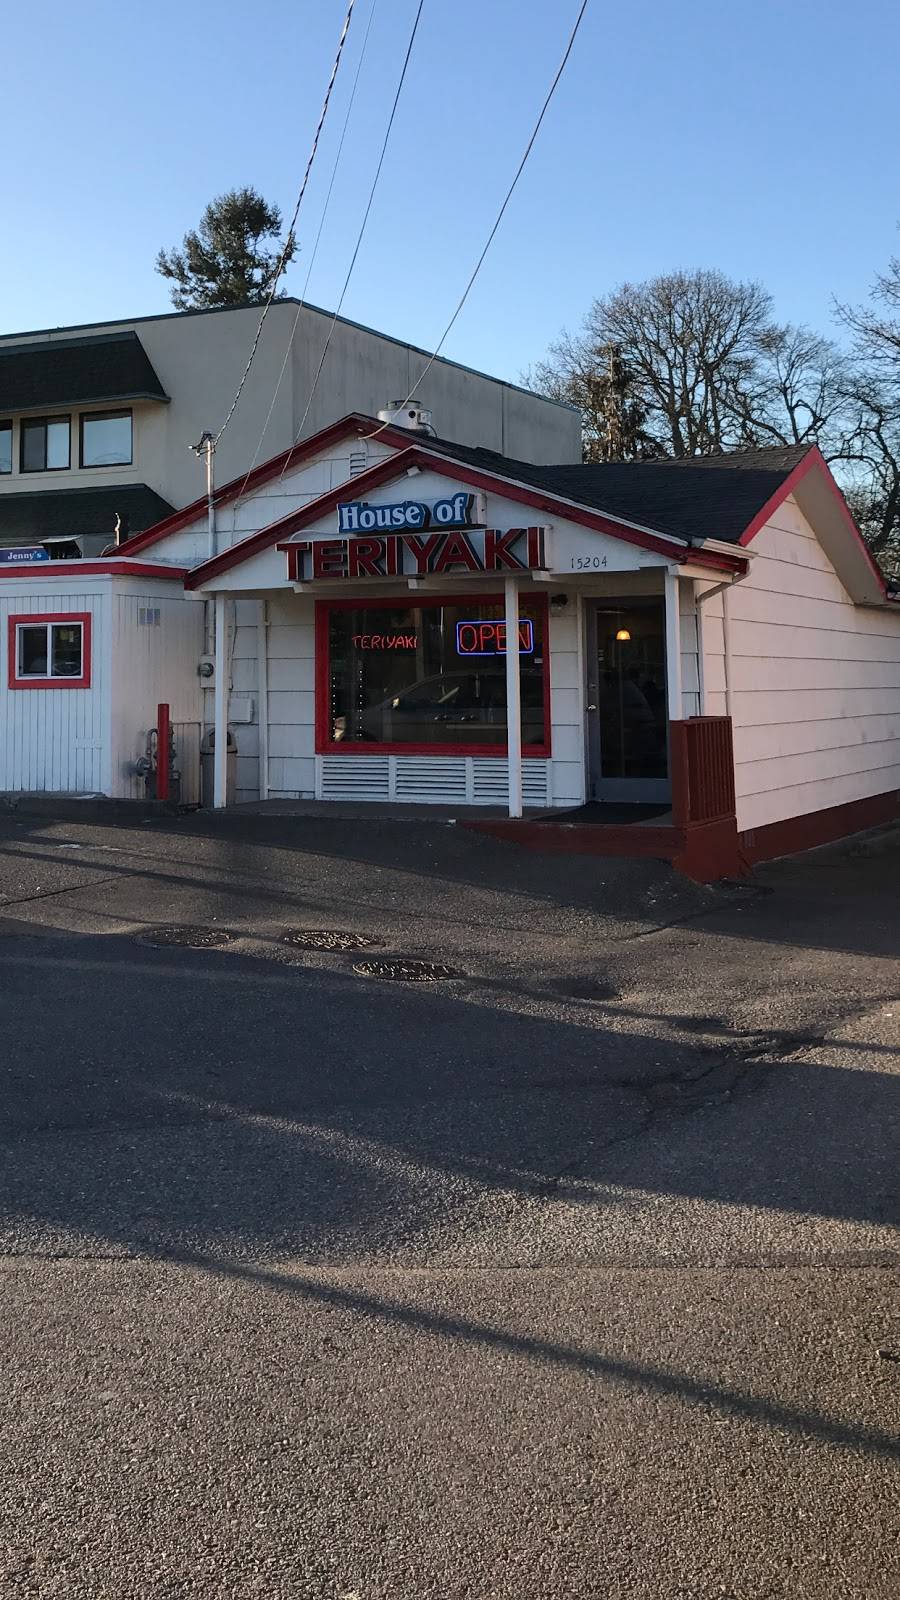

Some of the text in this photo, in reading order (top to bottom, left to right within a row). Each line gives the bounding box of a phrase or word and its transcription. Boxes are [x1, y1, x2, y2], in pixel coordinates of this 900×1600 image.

[341, 496, 465, 530] House of
[8, 551, 42, 560] Jenny's
[275, 527, 547, 581] TERIYAKI
[571, 556, 608, 569] 15204
[352, 635, 418, 650] TERIYAKI
[459, 623, 531, 652] OPEN
